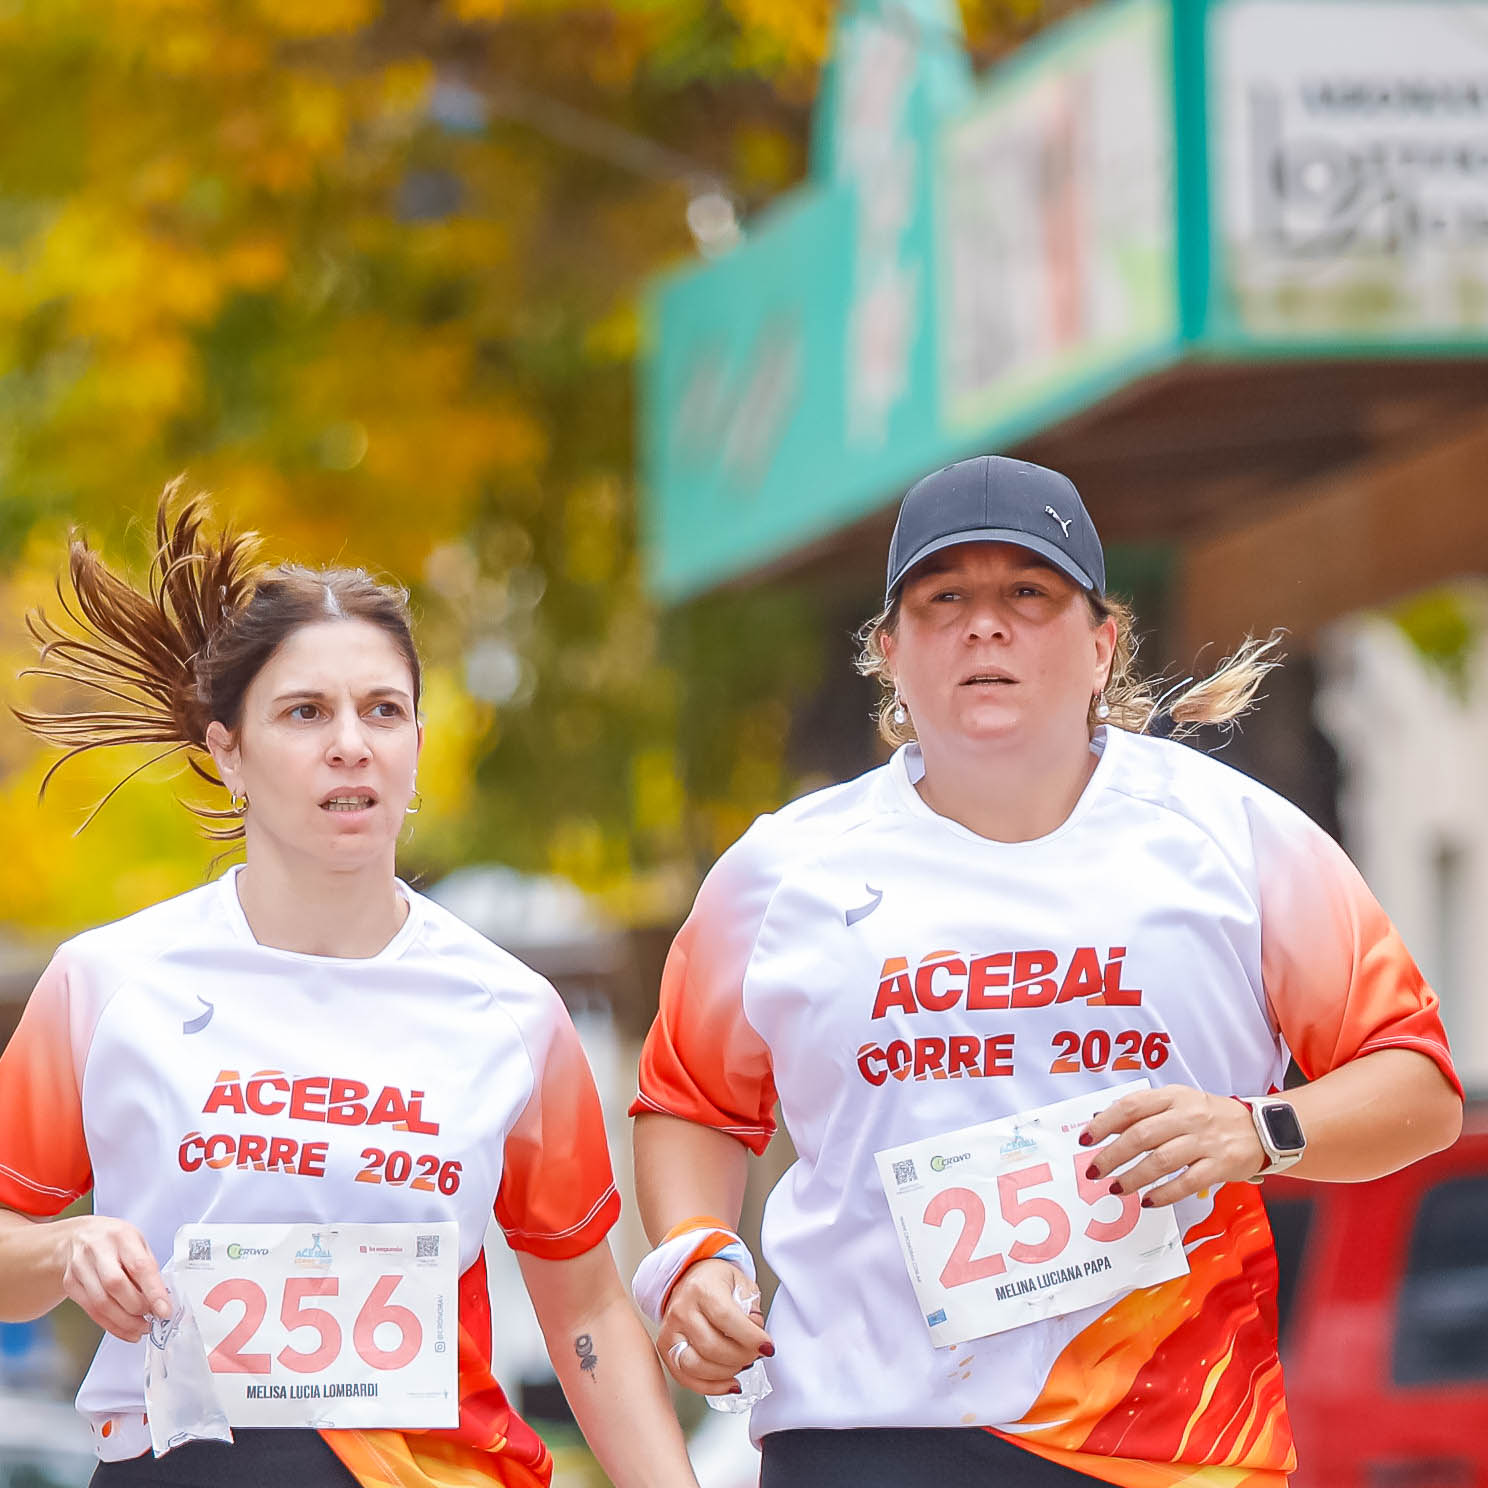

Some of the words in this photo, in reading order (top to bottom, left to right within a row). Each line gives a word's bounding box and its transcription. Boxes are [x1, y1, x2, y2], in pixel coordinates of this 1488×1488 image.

[871, 946, 1143, 1020] ACEBAL
[856, 1033, 1015, 1087] CORRE
[1049, 1029, 1171, 1075] 2026
[202, 1069, 440, 1136] ACEBAL
[178, 1131, 329, 1178] CORRE
[354, 1147, 463, 1196] 2026
[922, 1146, 1141, 1290] 255
[995, 1278, 1037, 1301] MELINA
[1037, 1266, 1083, 1289] LUCIANA
[1083, 1256, 1112, 1277] PAPA
[202, 1274, 423, 1375] 256
[246, 1385, 287, 1399] MELISA
[290, 1384, 320, 1399] LUCIA
[323, 1383, 378, 1398] LOMBARDI
